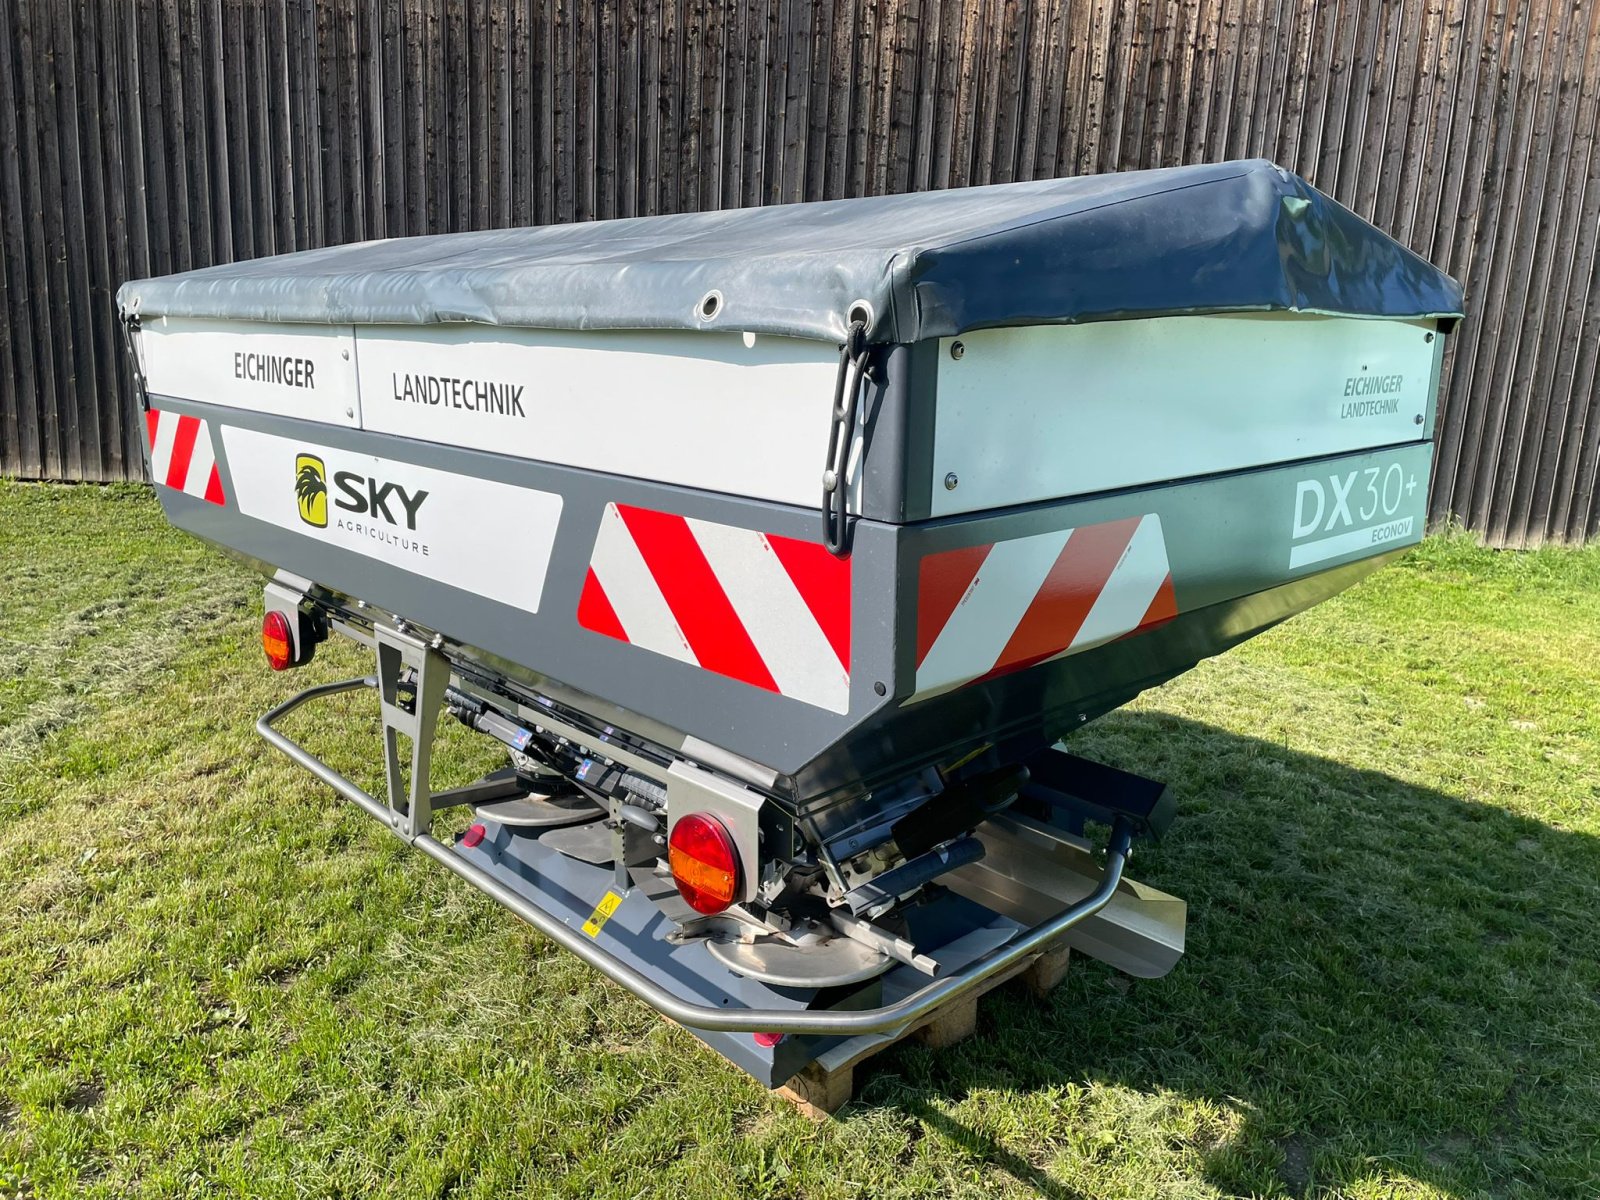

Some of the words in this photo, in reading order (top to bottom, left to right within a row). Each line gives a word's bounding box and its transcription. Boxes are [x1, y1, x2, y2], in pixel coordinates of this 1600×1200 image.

[234, 352, 315, 389] EICHINGER
[393, 372, 526, 418] LANDTECHNIK
[1344, 375, 1403, 397] EICHINGER
[1341, 399, 1399, 419] LANDTECHNIK
[334, 470, 430, 531] SKY
[337, 519, 430, 556] AGRICULTURE
[1371, 520, 1411, 543] ECONOV
